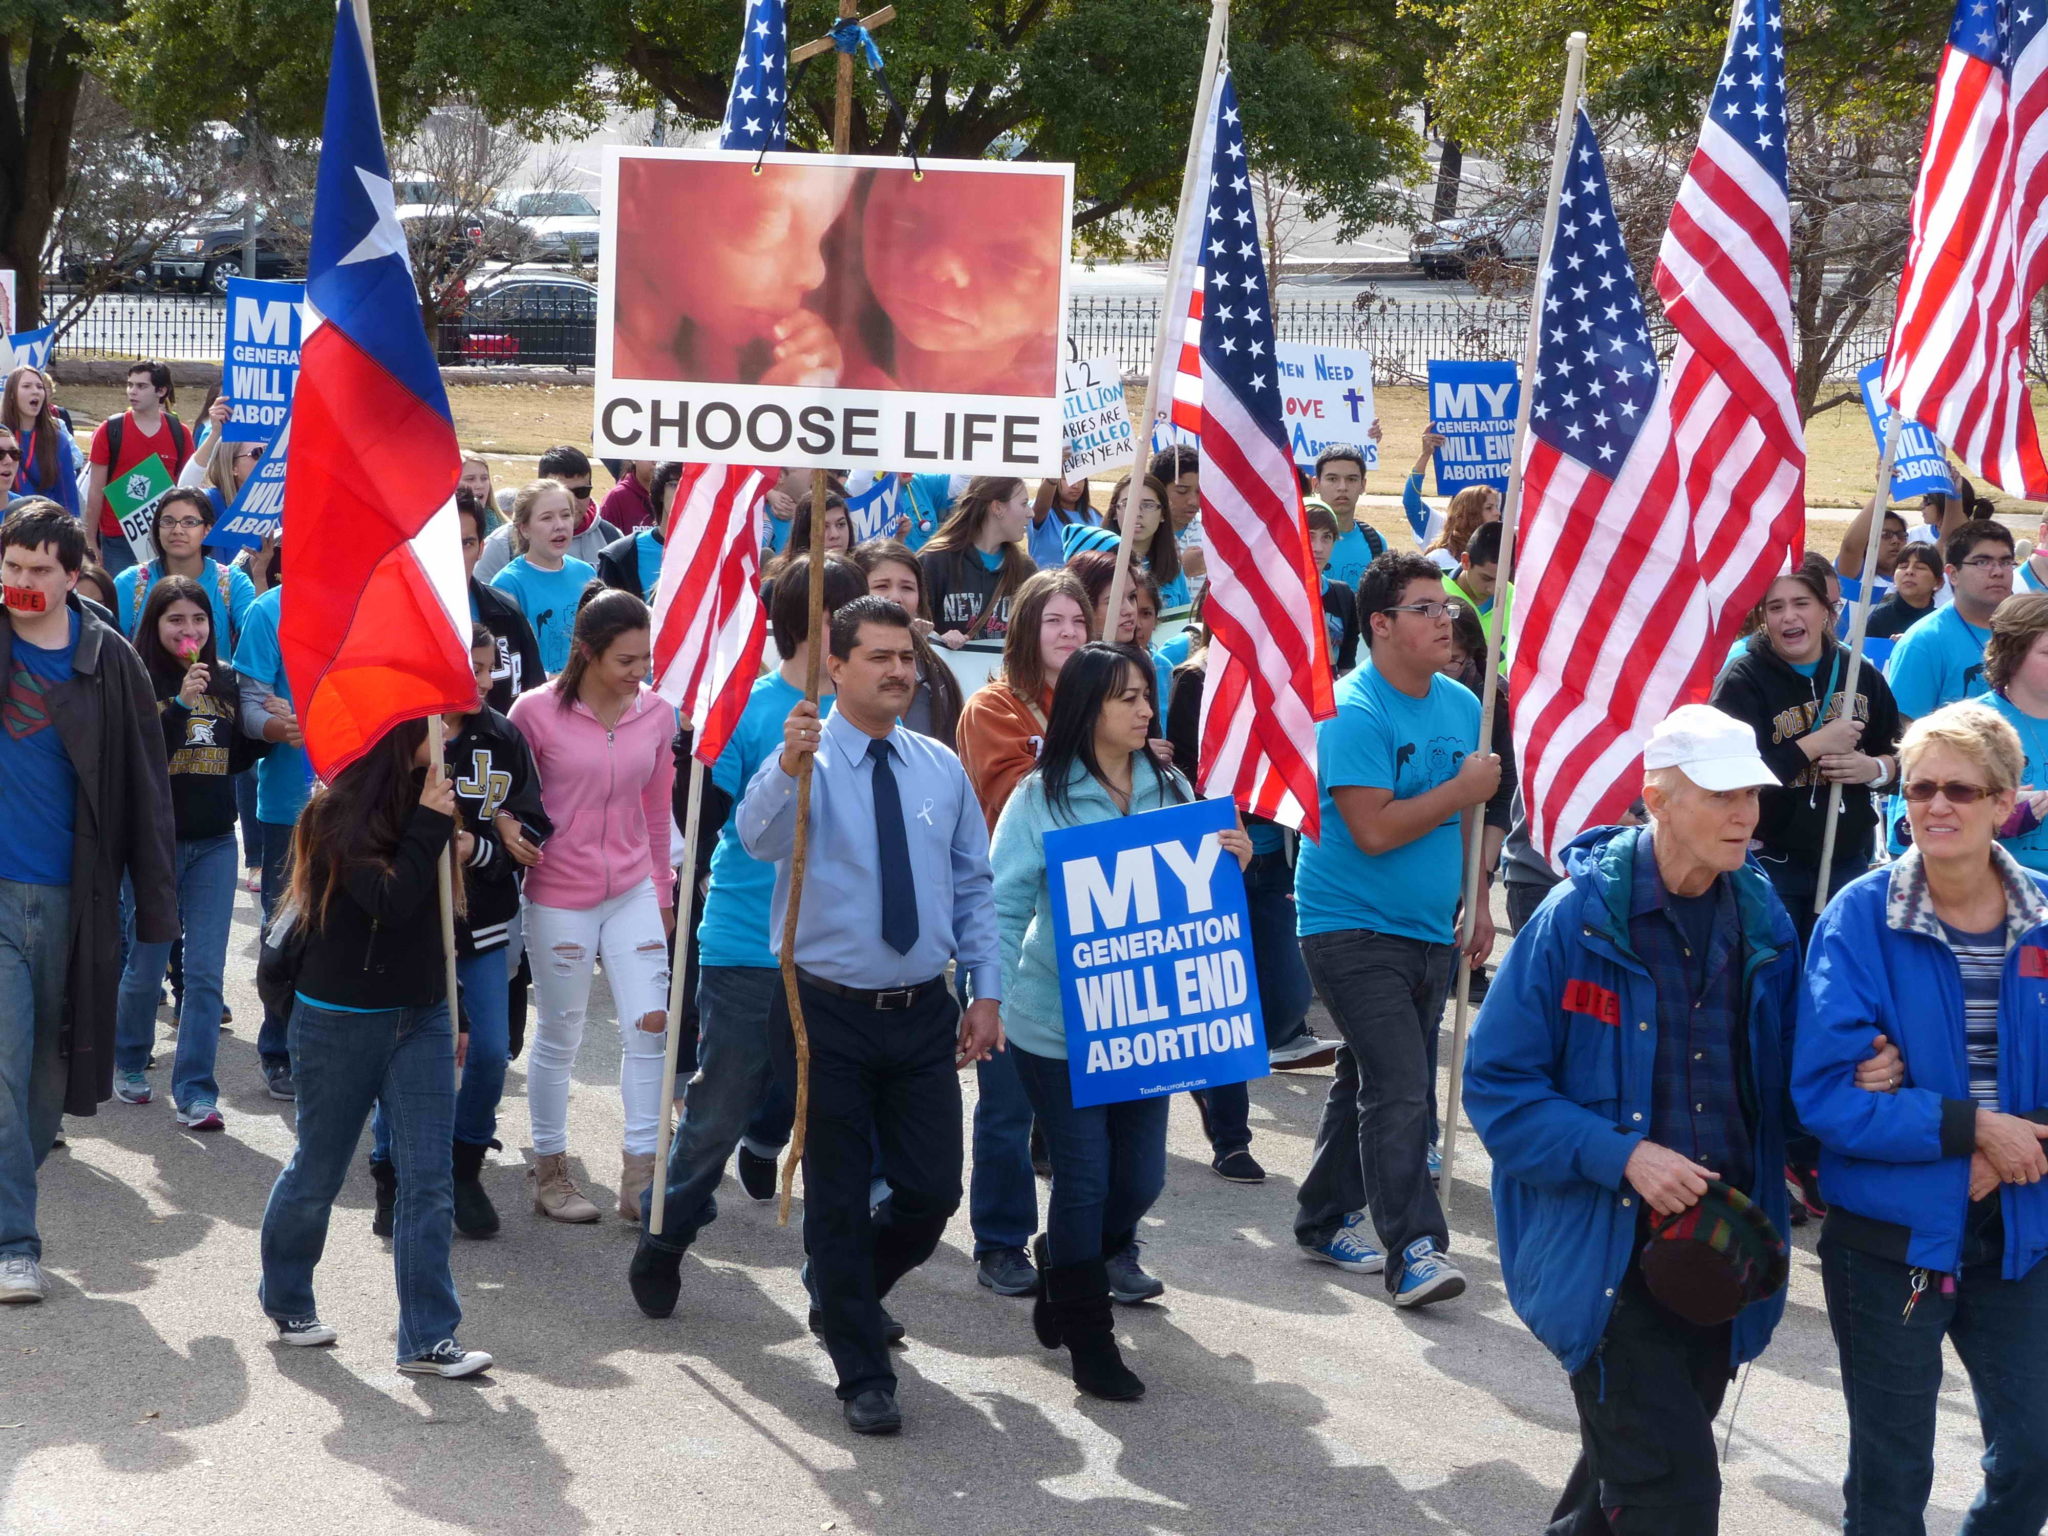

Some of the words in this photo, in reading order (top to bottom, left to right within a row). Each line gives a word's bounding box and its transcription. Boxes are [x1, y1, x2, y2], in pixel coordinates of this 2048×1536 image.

[234, 297, 303, 346] M
[233, 345, 302, 365] GENERA
[232, 366, 285, 402] WILL
[1434, 382, 1514, 418] MY
[1062, 417, 1096, 439] ABIES
[1100, 406, 1121, 427] ARE
[1286, 396, 1325, 419] OVE
[601, 397, 879, 457] CHOOSE
[904, 411, 1040, 464] LIFE
[1071, 421, 1130, 453] KILLED
[1062, 450, 1096, 474] EVERY
[1097, 438, 1134, 461] YEAR
[1441, 436, 1482, 462] WILL
[1443, 463, 1512, 481] ABORTIO
[122, 500, 159, 542] DEF
[850, 477, 899, 543] MY
[9, 590, 40, 609] LIFE
[943, 592, 983, 622] NEW
[1062, 832, 1223, 936] MY
[1072, 912, 1241, 969] GENERATION
[1075, 965, 1169, 1032] WILL
[1174, 949, 1248, 1016] END
[1086, 1013, 1255, 1074] ABORTION
